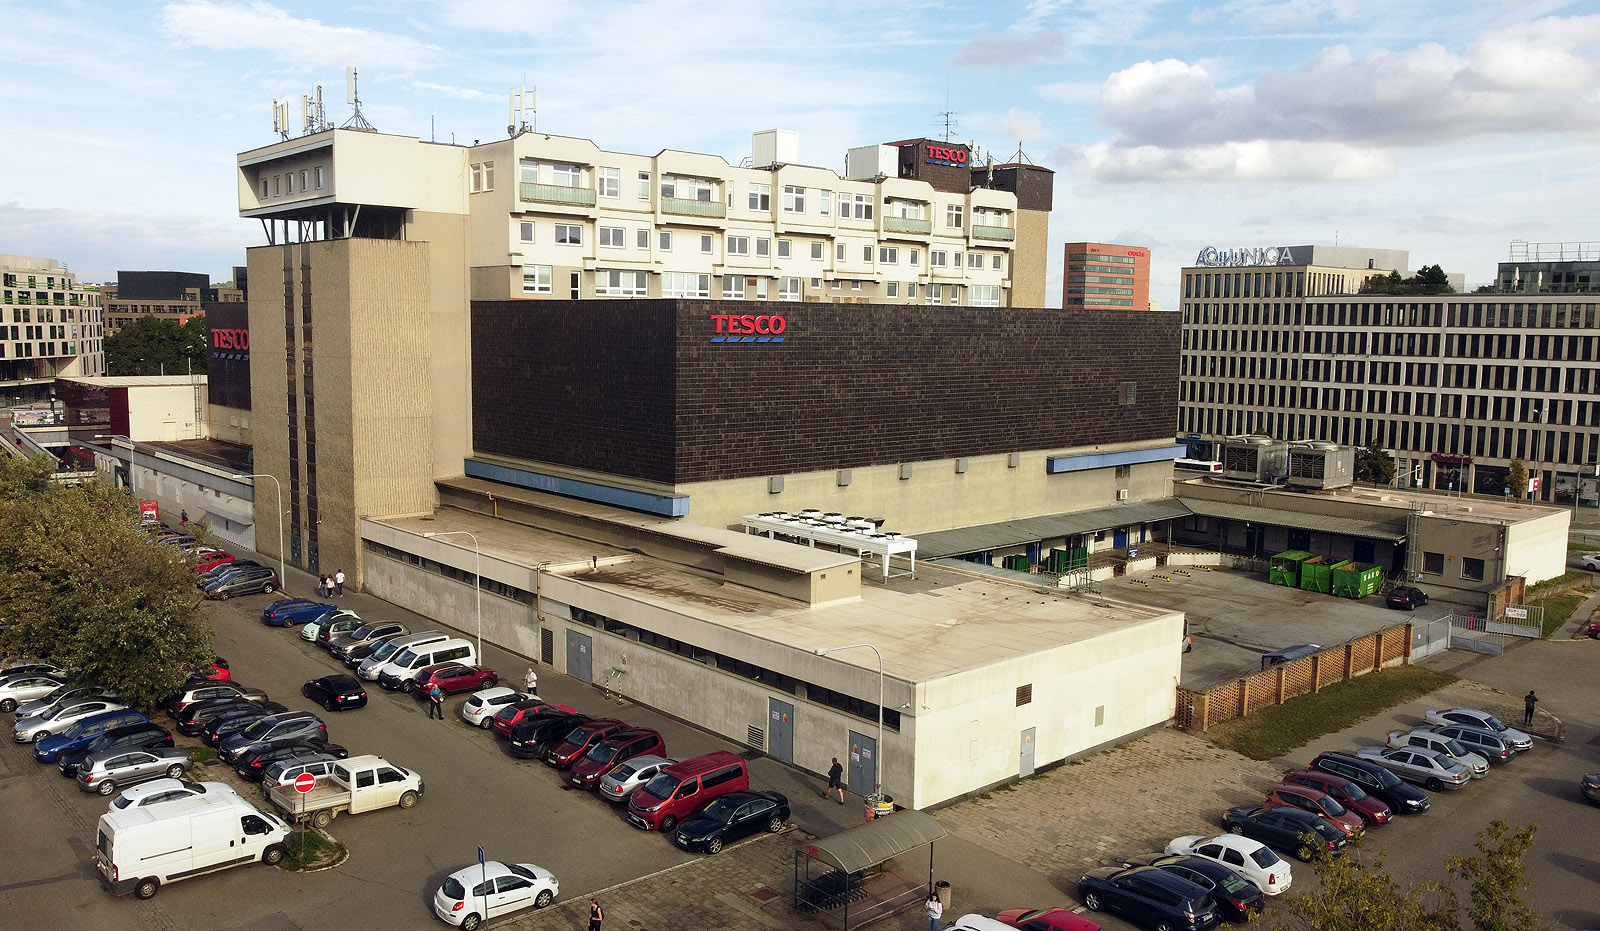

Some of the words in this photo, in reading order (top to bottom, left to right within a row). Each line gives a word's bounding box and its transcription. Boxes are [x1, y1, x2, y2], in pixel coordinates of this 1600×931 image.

[926, 146, 966, 163] TESCO
[710, 314, 786, 335] TESCO
[211, 328, 249, 350] TESCO
[1363, 570, 1380, 582] SAKO
